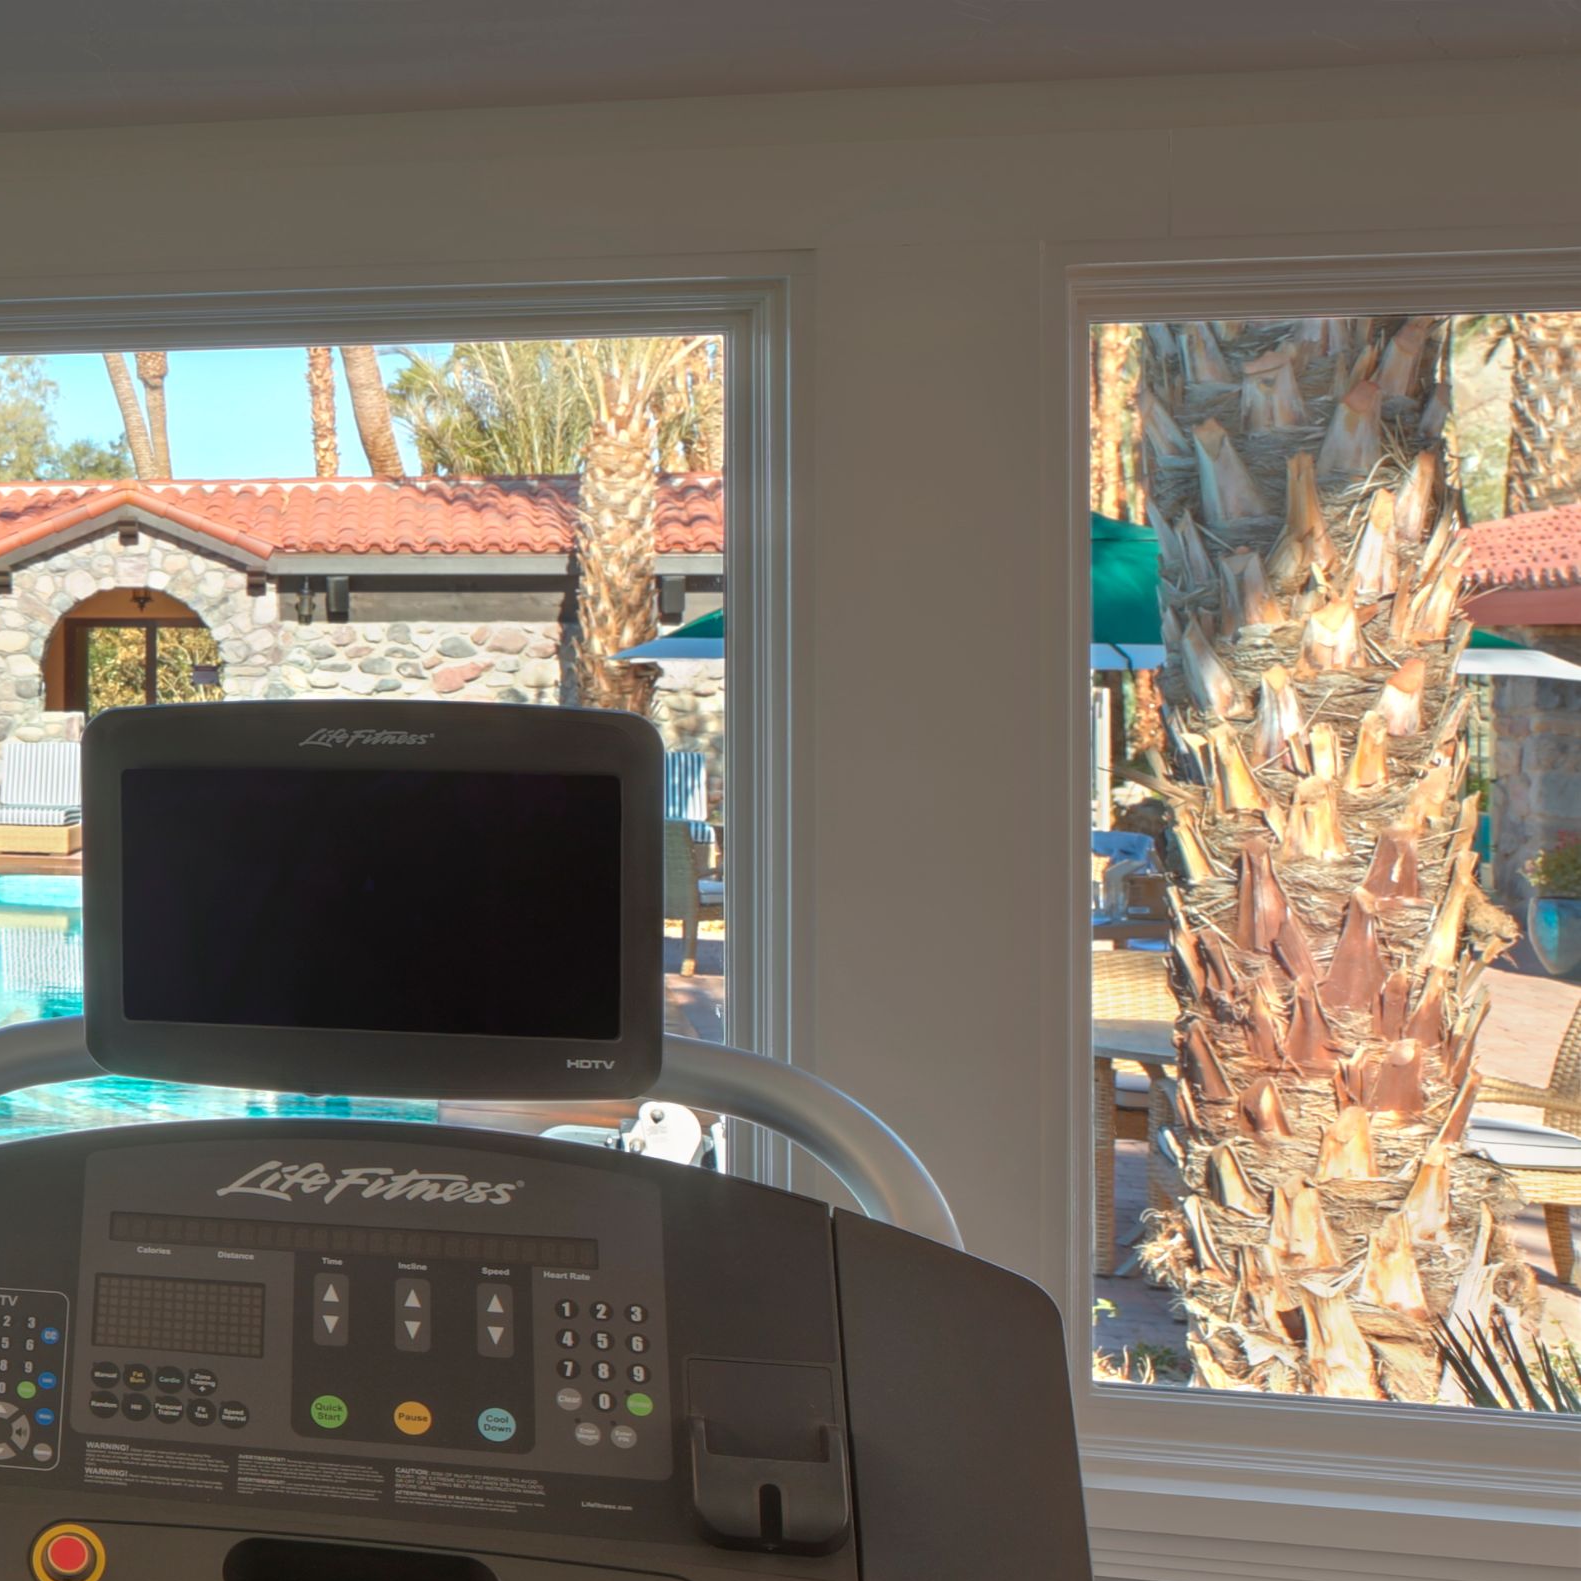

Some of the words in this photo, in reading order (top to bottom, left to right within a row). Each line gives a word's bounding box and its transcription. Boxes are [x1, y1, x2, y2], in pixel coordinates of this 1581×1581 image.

[566, 1059, 615, 1069] HDTV
[137, 1246, 171, 1255] Calories
[217, 1251, 254, 1260] Distance
[322, 1257, 343, 1266] Time
[398, 1262, 427, 1272] Incline
[481, 1267, 510, 1277] Speed
[543, 1270, 568, 1280] Heart
[570, 1272, 591, 1281] Rate
[0, 1295, 18, 1306] TV
[561, 1301, 571, 1317] 1
[596, 1303, 607, 1319] 2
[630, 1305, 642, 1322] 3
[2, 1315, 11, 1327] 2
[28, 1317, 36, 1329] 3
[1, 1337, 10, 1349] 5
[26, 1339, 34, 1351] 6
[562, 1331, 574, 1347] 4
[596, 1333, 608, 1349] 5
[631, 1336, 644, 1352] 6
[0, 1359, 8, 1372] 8
[24, 1361, 33, 1373] 9
[563, 1361, 573, 1377] 7
[598, 1363, 610, 1379] 8
[633, 1365, 645, 1382] 9
[159, 1376, 181, 1384] Cardio
[598, 1393, 611, 1410] 0
[314, 1402, 343, 1413] Quick
[317, 1412, 341, 1421] Start
[398, 1412, 428, 1423] Pause
[485, 1415, 509, 1424] Cool
[483, 1423, 512, 1433] Down
[85, 1441, 130, 1452] WARNING!
[84, 1466, 129, 1477] WARNING!
